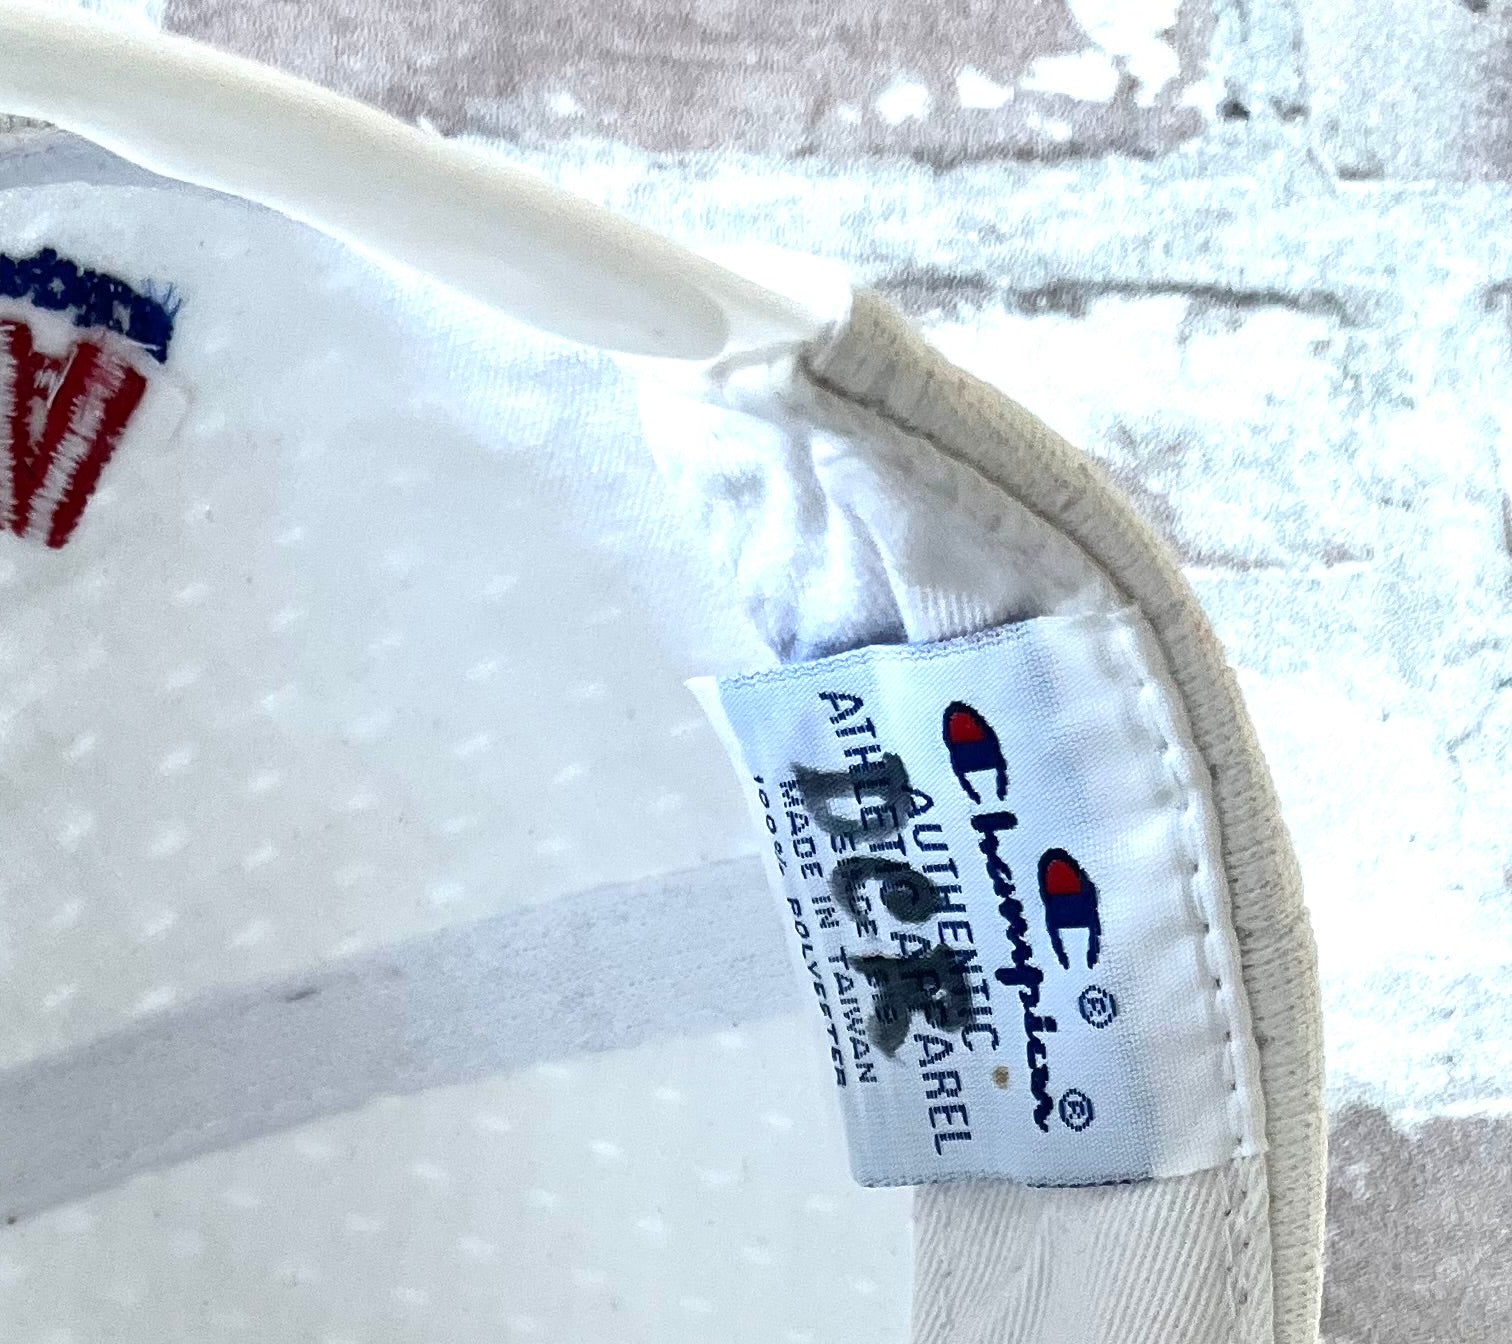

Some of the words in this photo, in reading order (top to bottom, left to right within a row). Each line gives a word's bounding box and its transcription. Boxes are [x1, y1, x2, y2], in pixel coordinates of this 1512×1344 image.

[752, 773, 786, 877] 100%
[779, 778, 824, 880] MADE
[811, 896, 840, 930] IN
[828, 946, 878, 1084] TAIWAN
[906, 787, 1000, 1053] AUTHENTIC
